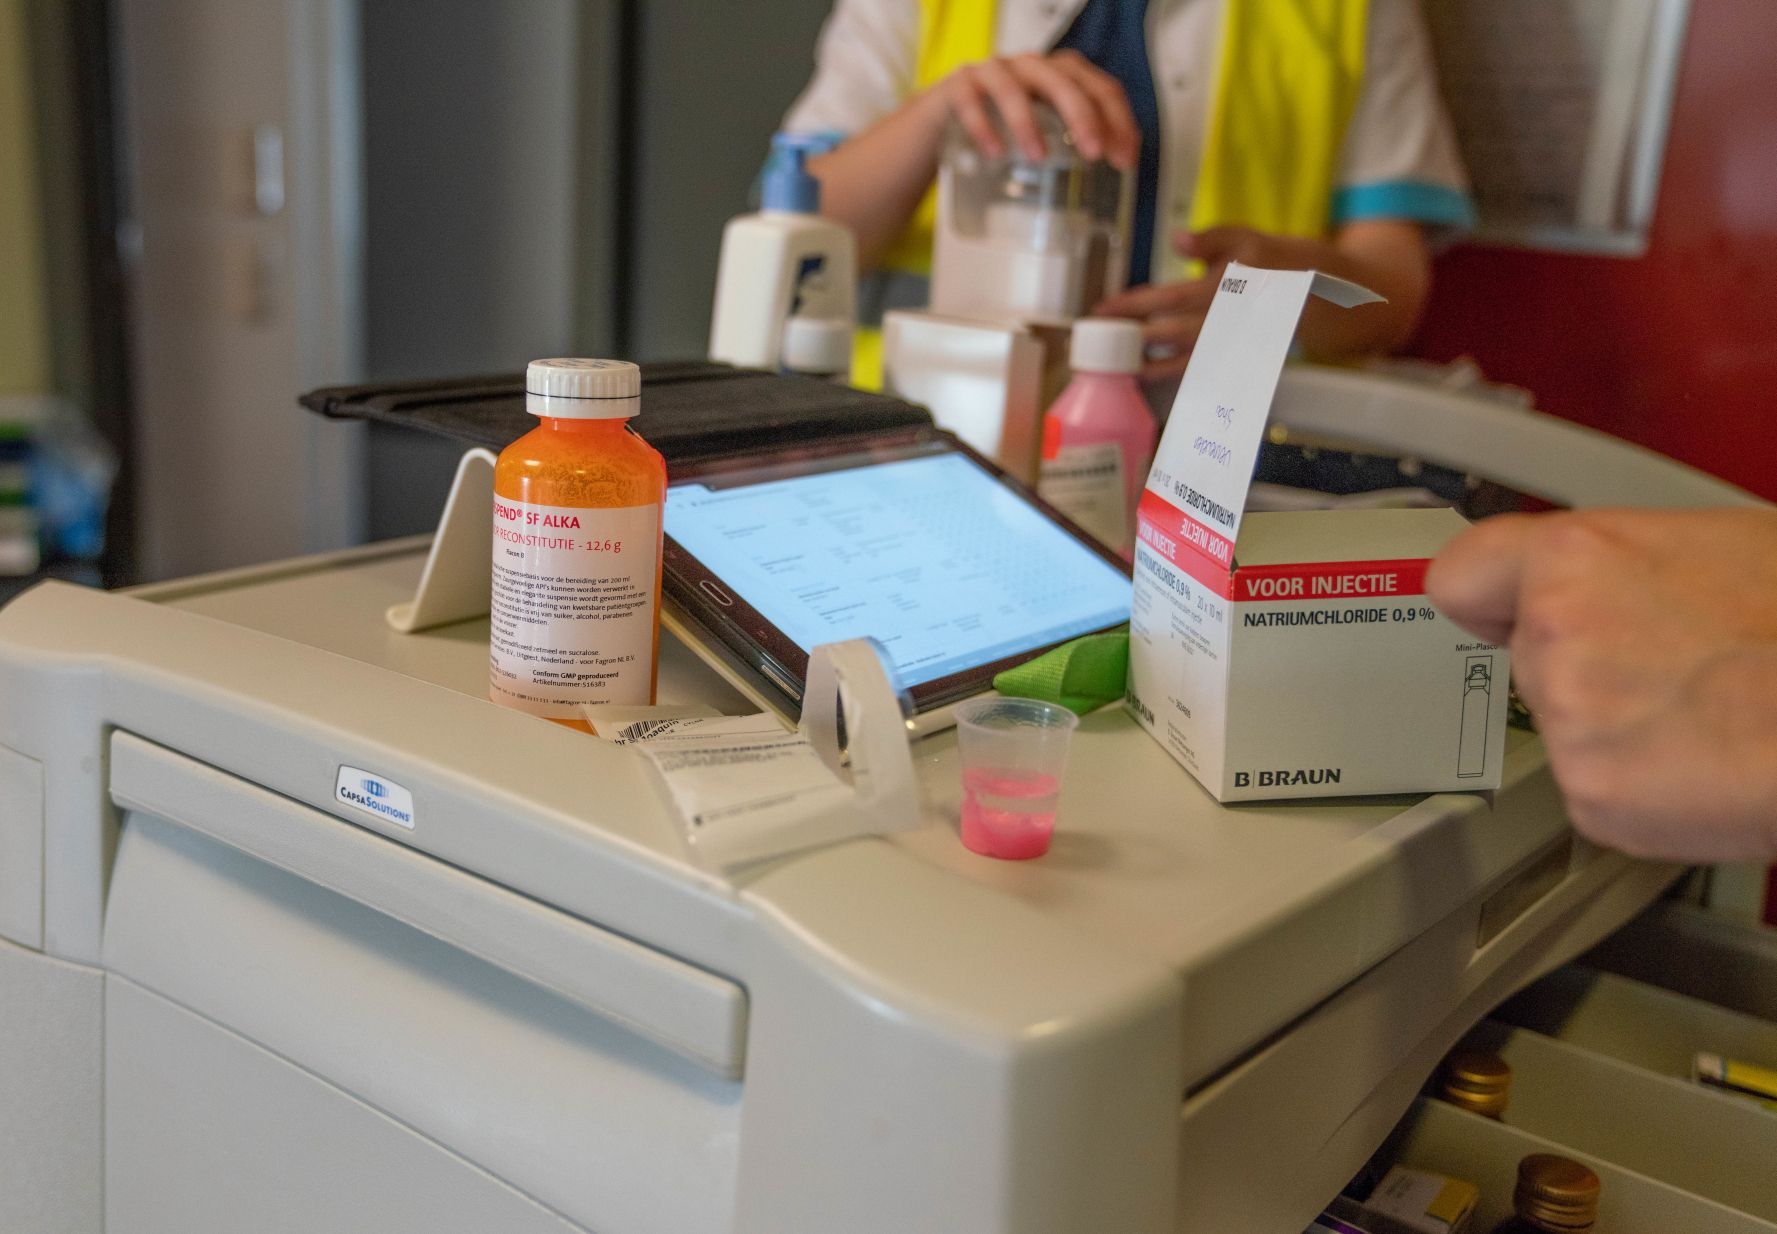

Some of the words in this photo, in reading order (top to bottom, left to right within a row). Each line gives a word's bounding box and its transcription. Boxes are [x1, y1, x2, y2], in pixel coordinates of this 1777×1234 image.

[1186, 488, 1236, 529] NATRIUMCHLORIDE
[526, 511, 540, 525] SF
[543, 515, 581, 529] ALKA
[499, 528, 575, 551] RECONSTITUTIE
[586, 541, 611, 552] 12,6
[614, 541, 622, 553] g
[1139, 519, 1153, 540] VOOR
[1153, 528, 1176, 560] INJECTIE
[1180, 518, 1209, 550] INJECTIE
[1209, 535, 1229, 562] VOOR
[551, 585, 575, 593] kunnen
[602, 585, 629, 593] verwerkt
[565, 577, 597, 585] bereiding
[1136, 547, 1176, 590] NATRIUMCHLORIDE
[1176, 579, 1185, 597] 0,9
[1197, 595, 1203, 611] 20
[1216, 609, 1222, 625] ml
[1246, 578, 1304, 597] VOOR
[1311, 573, 1397, 595] INJECTIE
[522, 599, 558, 611] behandeling
[572, 603, 606, 611] kwetsbare
[546, 594, 578, 602] suspensie
[599, 594, 627, 604] gevormd
[553, 612, 575, 620] suiker,
[1244, 608, 1387, 627] NATRIUMCHLORIDE
[1392, 607, 1416, 623] 0,9
[1419, 607, 1435, 621] %
[541, 656, 574, 665] Nederland
[595, 658, 617, 666] Fagron
[532, 669, 560, 678] Conform
[560, 671, 577, 679] GMP
[577, 671, 619, 681] geproduceerd
[1234, 772, 1250, 787] B
[1258, 768, 1341, 787] BRAUN
